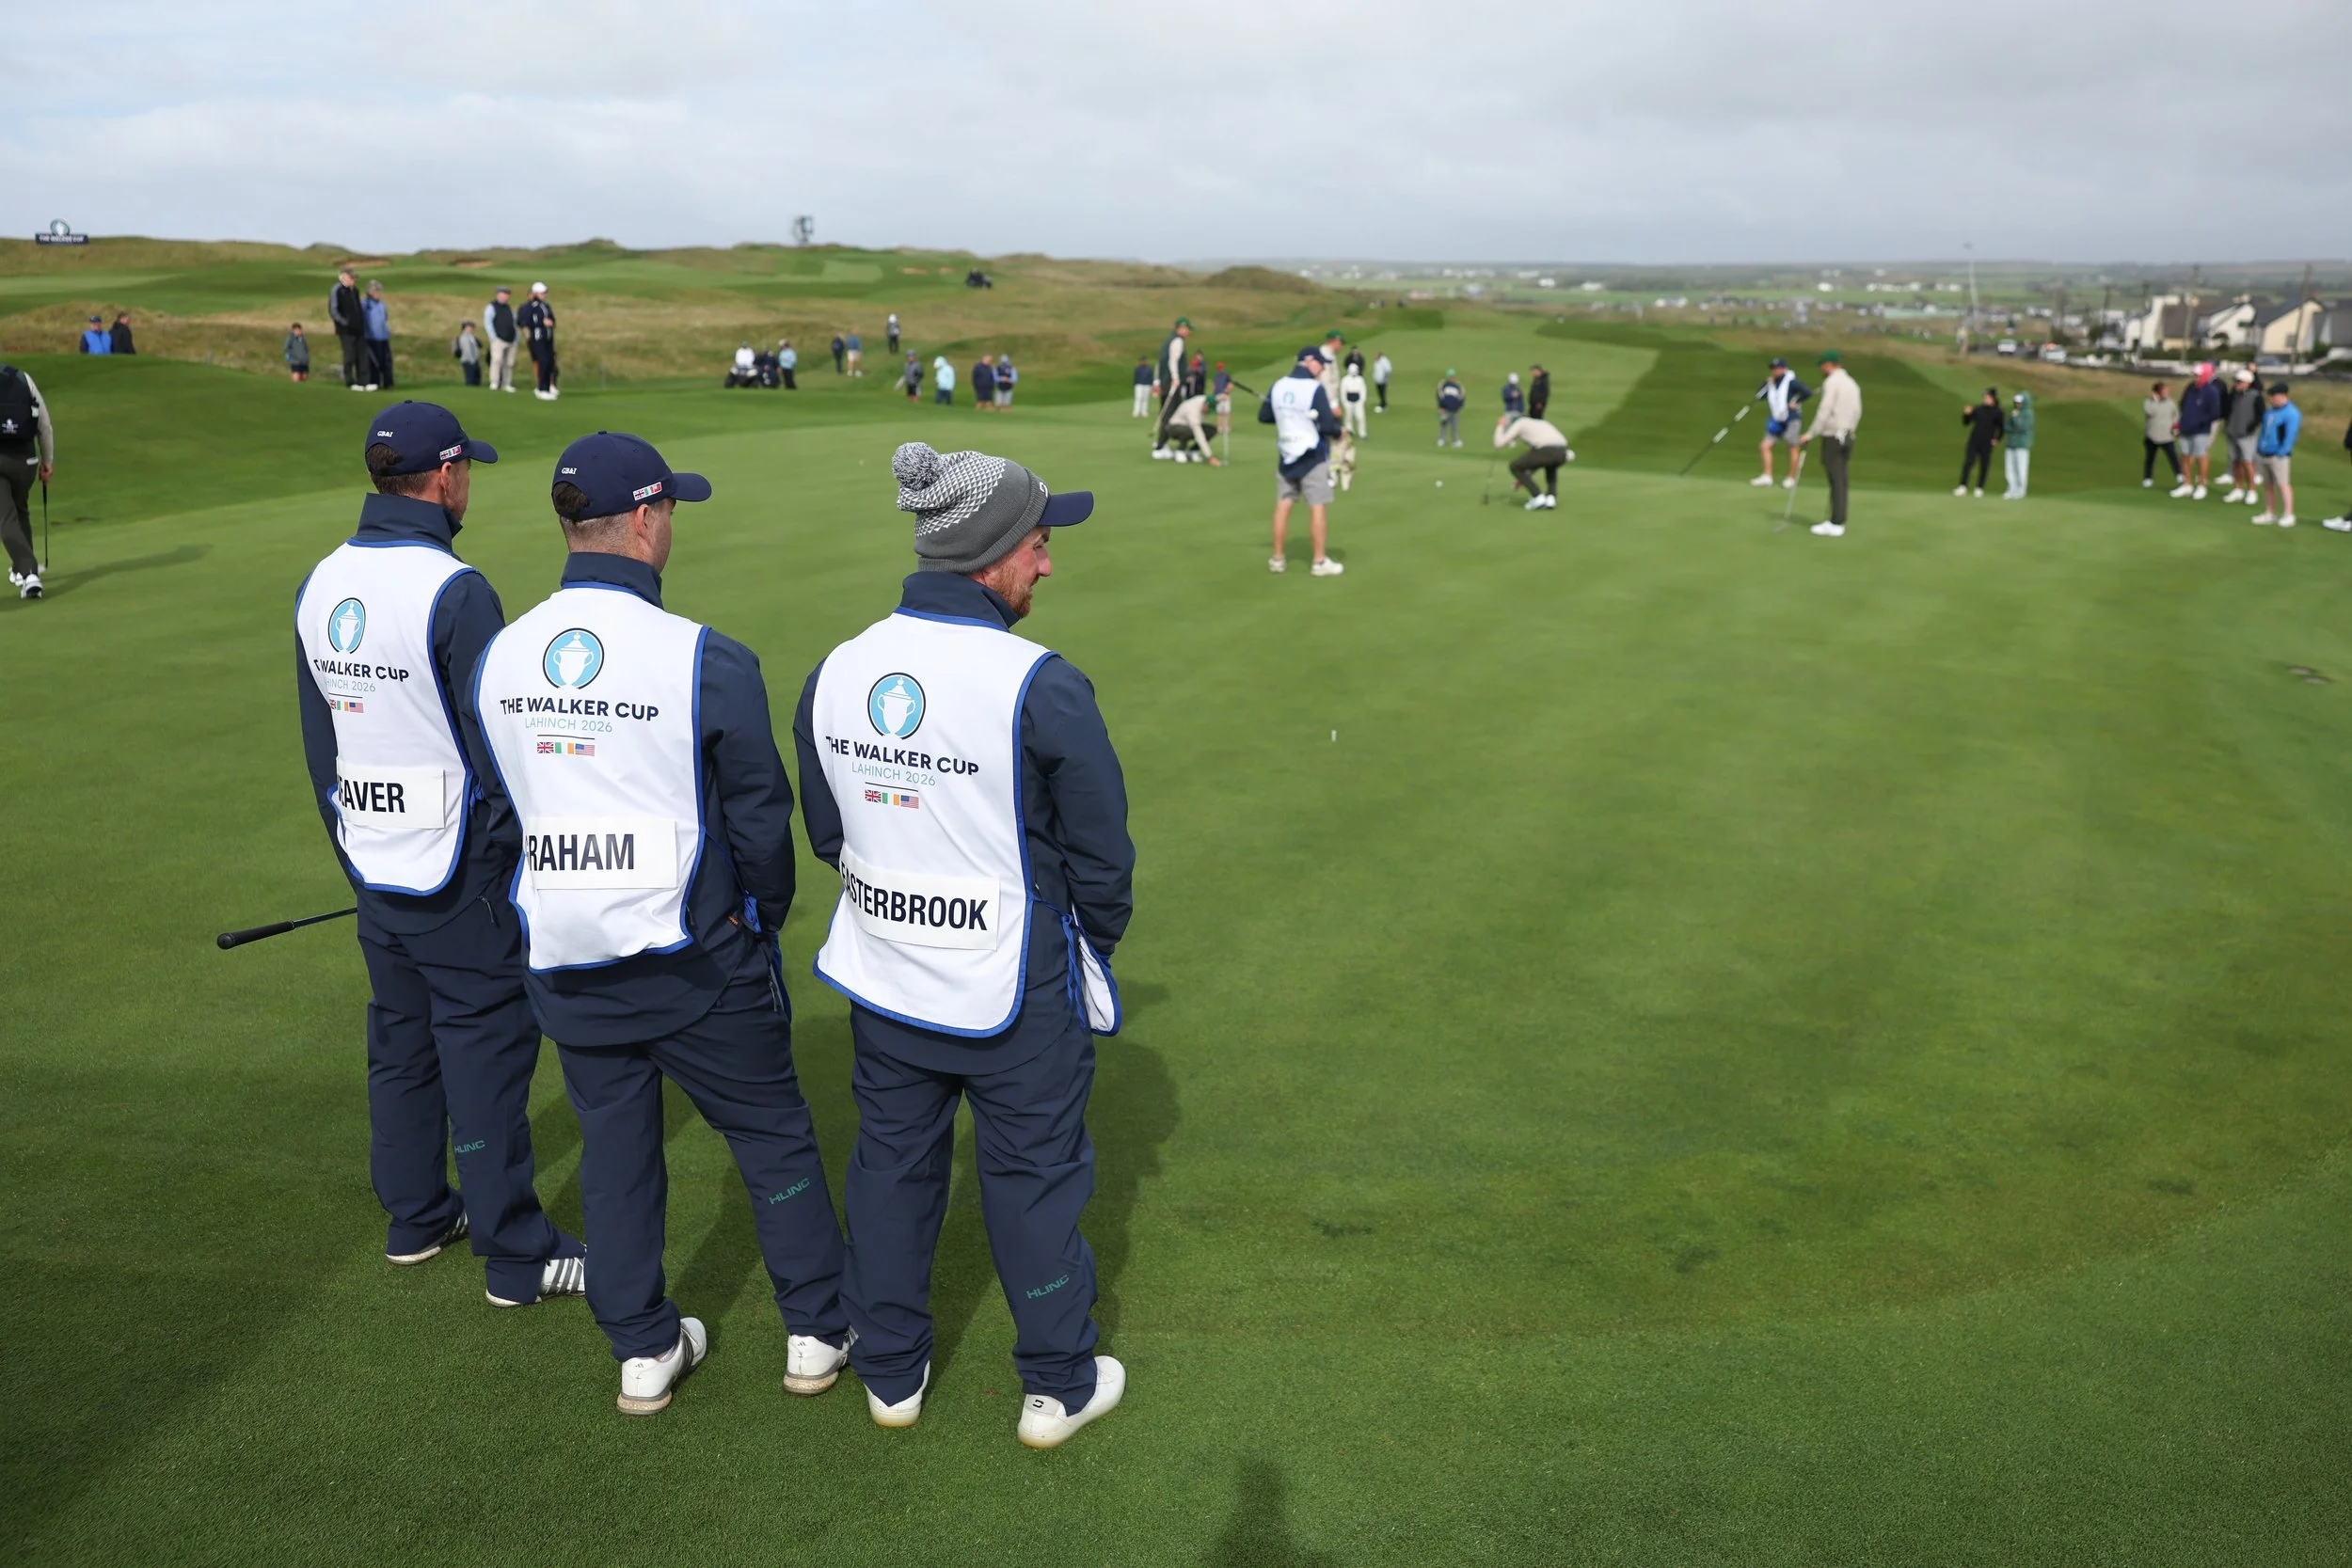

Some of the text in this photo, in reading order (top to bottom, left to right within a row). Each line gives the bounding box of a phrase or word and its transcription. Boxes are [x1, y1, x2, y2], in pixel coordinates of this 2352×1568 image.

[320, 658, 372, 678] WALKER
[375, 665, 409, 683] CUP
[352, 680, 376, 692] 2026
[500, 697, 659, 721] THE WALKER CUP
[525, 716, 612, 733] LAHINCH 2026
[825, 736, 979, 776] THE WALKER CUP
[851, 761, 936, 786] LAHINCH 2026
[338, 774, 405, 813] EAVER
[525, 833, 634, 871] RAHAM
